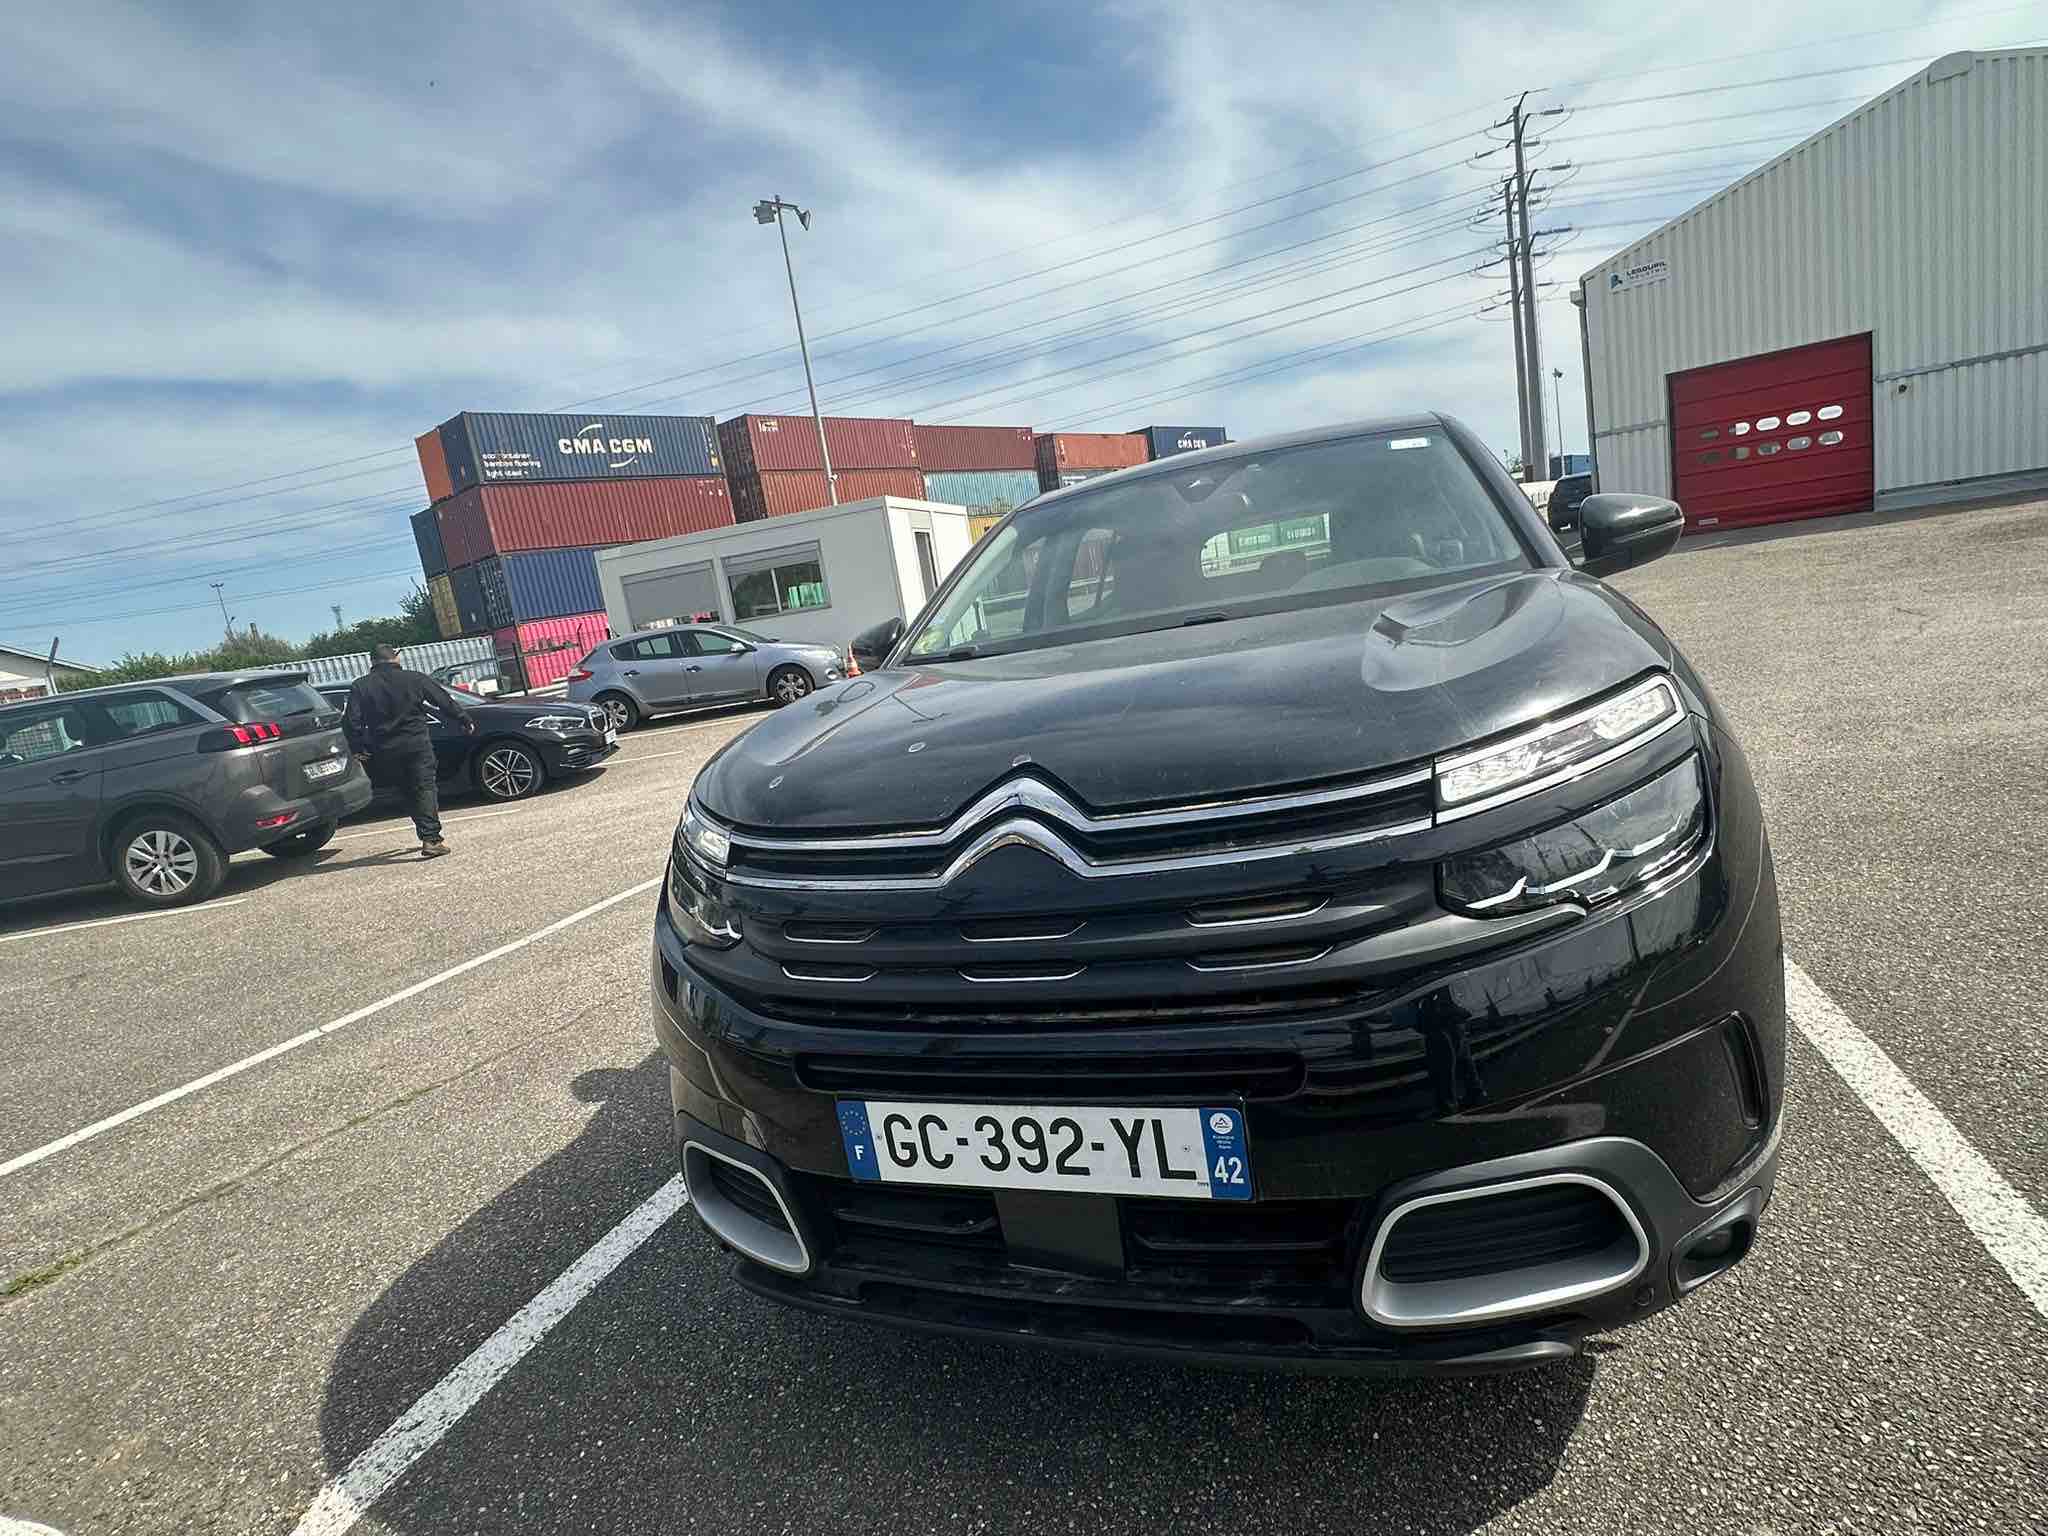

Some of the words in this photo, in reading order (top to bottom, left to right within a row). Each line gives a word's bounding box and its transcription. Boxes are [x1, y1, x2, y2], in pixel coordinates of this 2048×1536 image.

[558, 437, 606, 454] CMA
[608, 437, 653, 454] CGM
[1177, 439, 1193, 448] CMA
[853, 1146, 865, 1161] F
[883, 1112, 1198, 1181] GC-392-YL
[1214, 1155, 1245, 1184] 42
